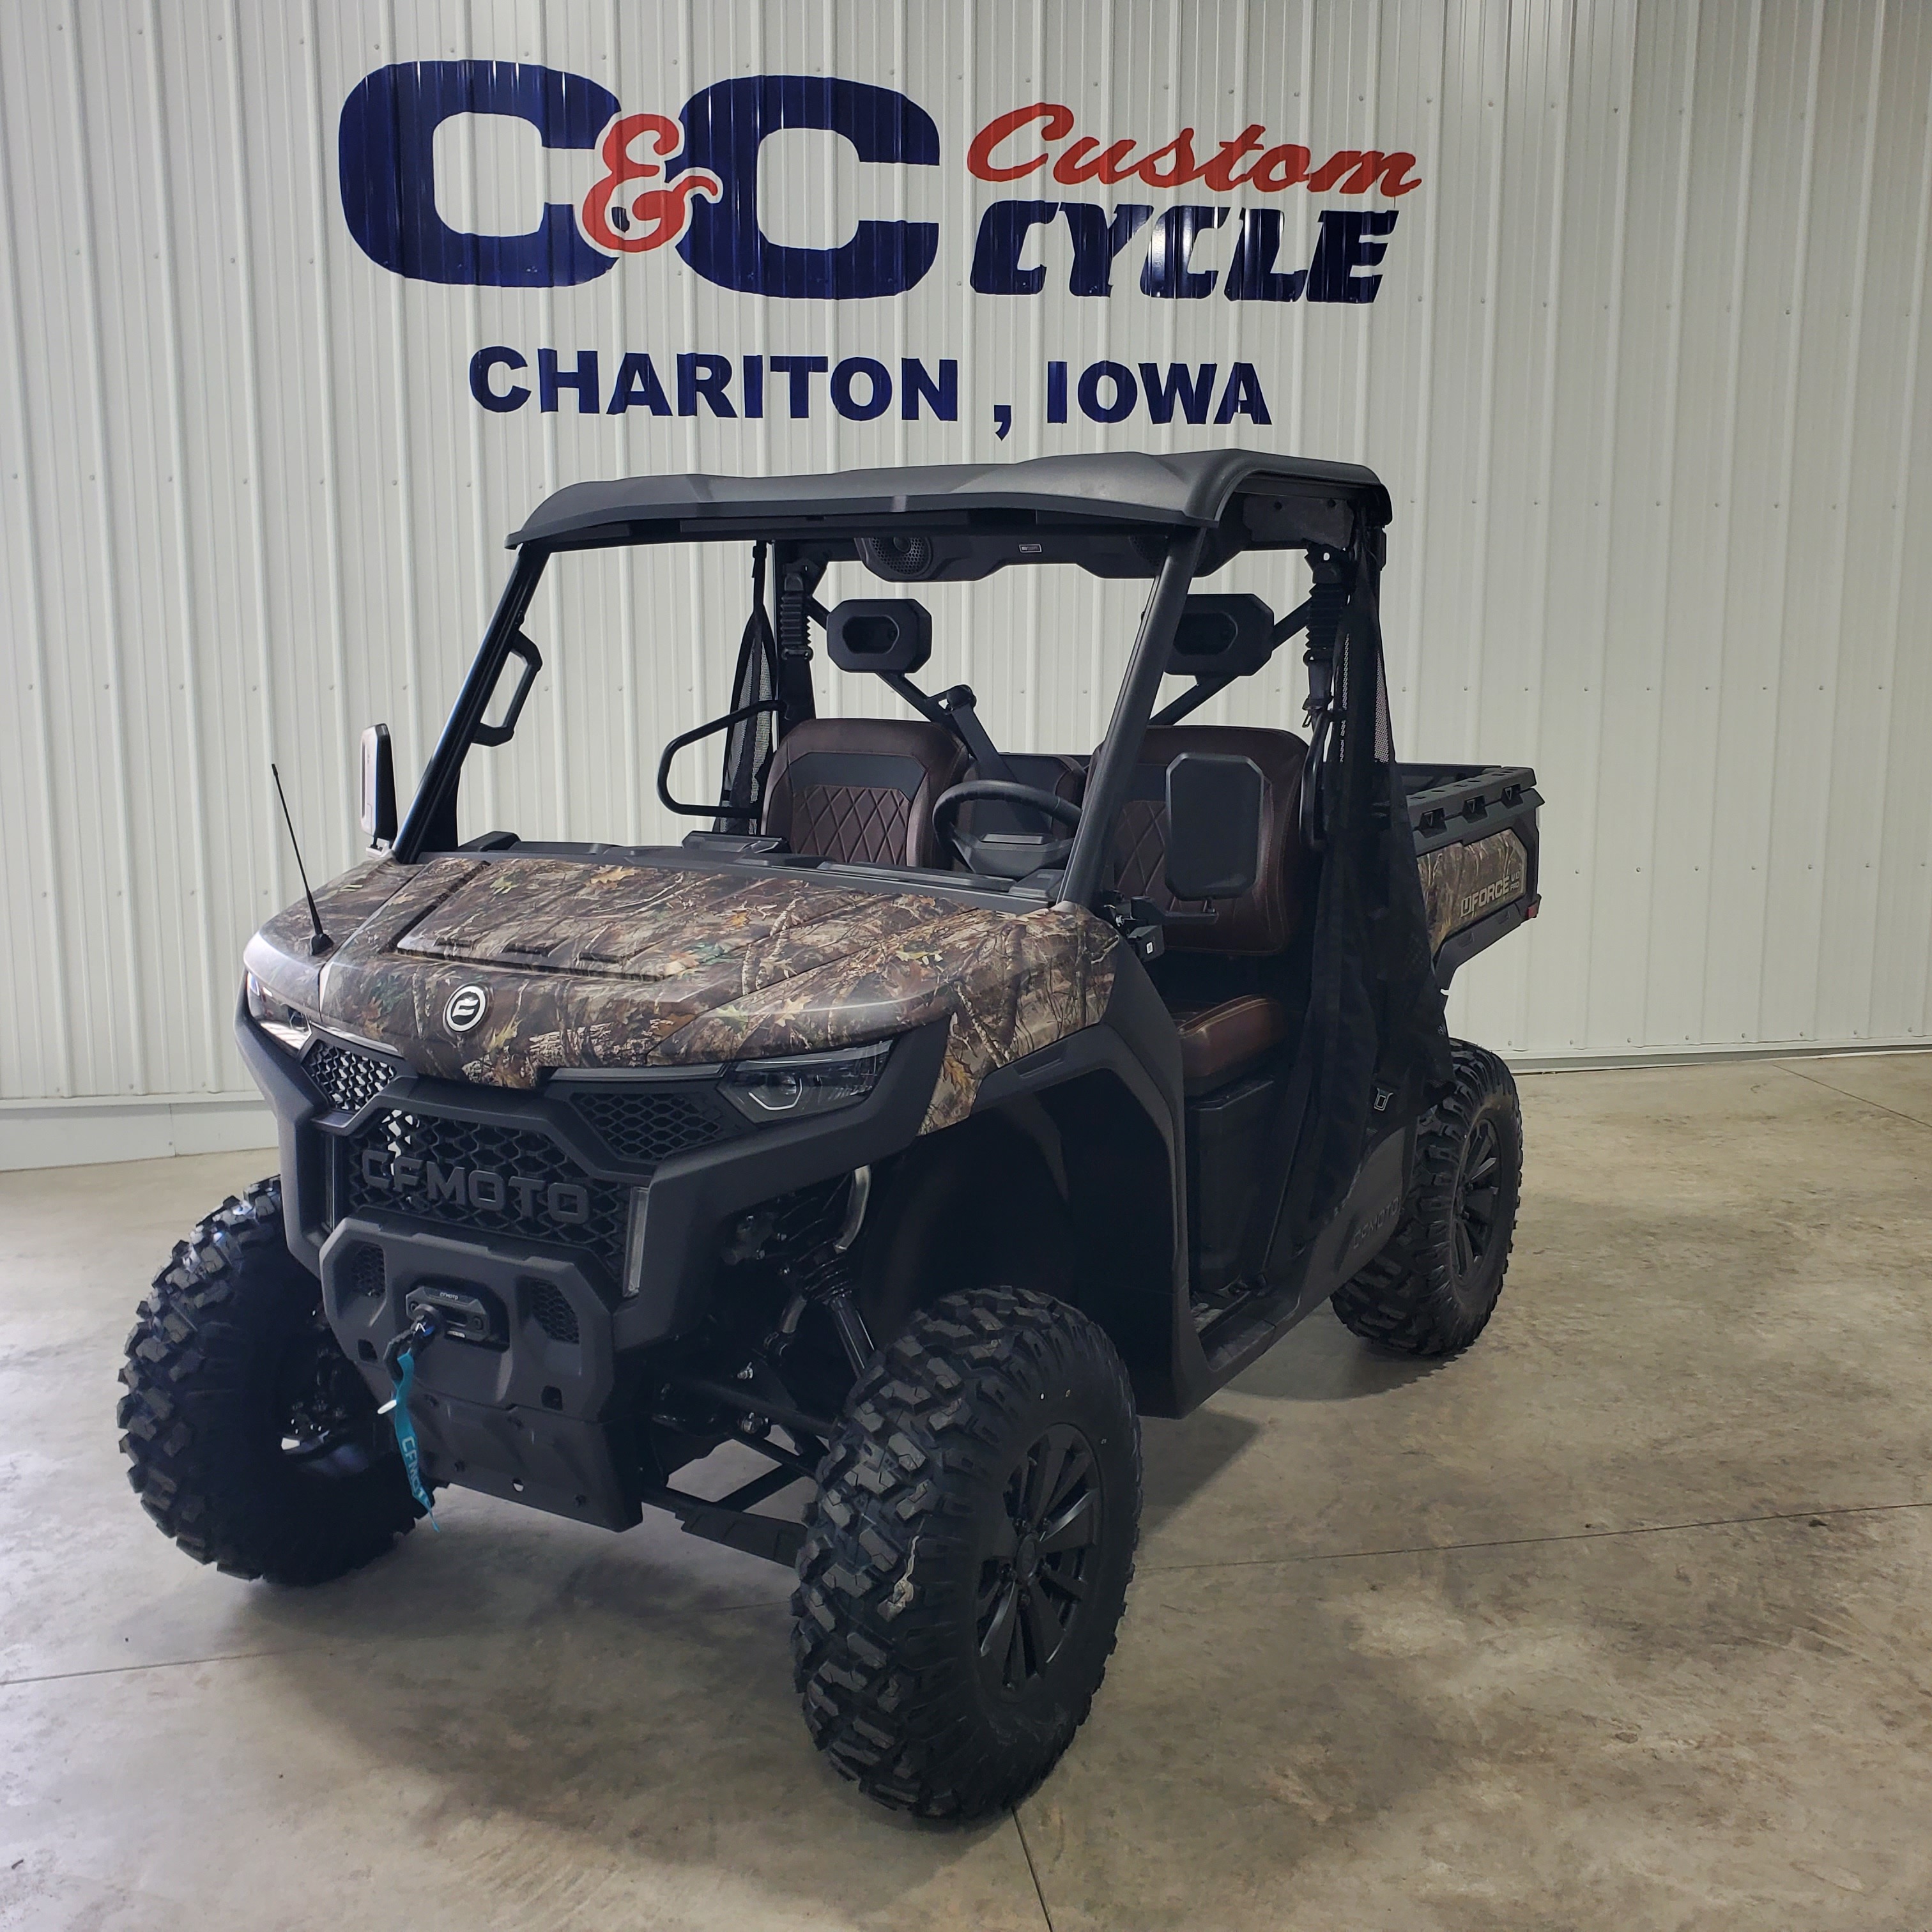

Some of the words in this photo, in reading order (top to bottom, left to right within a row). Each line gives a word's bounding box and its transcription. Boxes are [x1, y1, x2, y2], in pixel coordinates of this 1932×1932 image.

[339, 60, 939, 300] C&C
[967, 103, 1422, 197] Custom
[970, 200, 1399, 303] CYCLE
[470, 346, 958, 422] CHARITON
[1047, 360, 1272, 425] IOWA
[362, 1149, 590, 1225] CFMOTO
